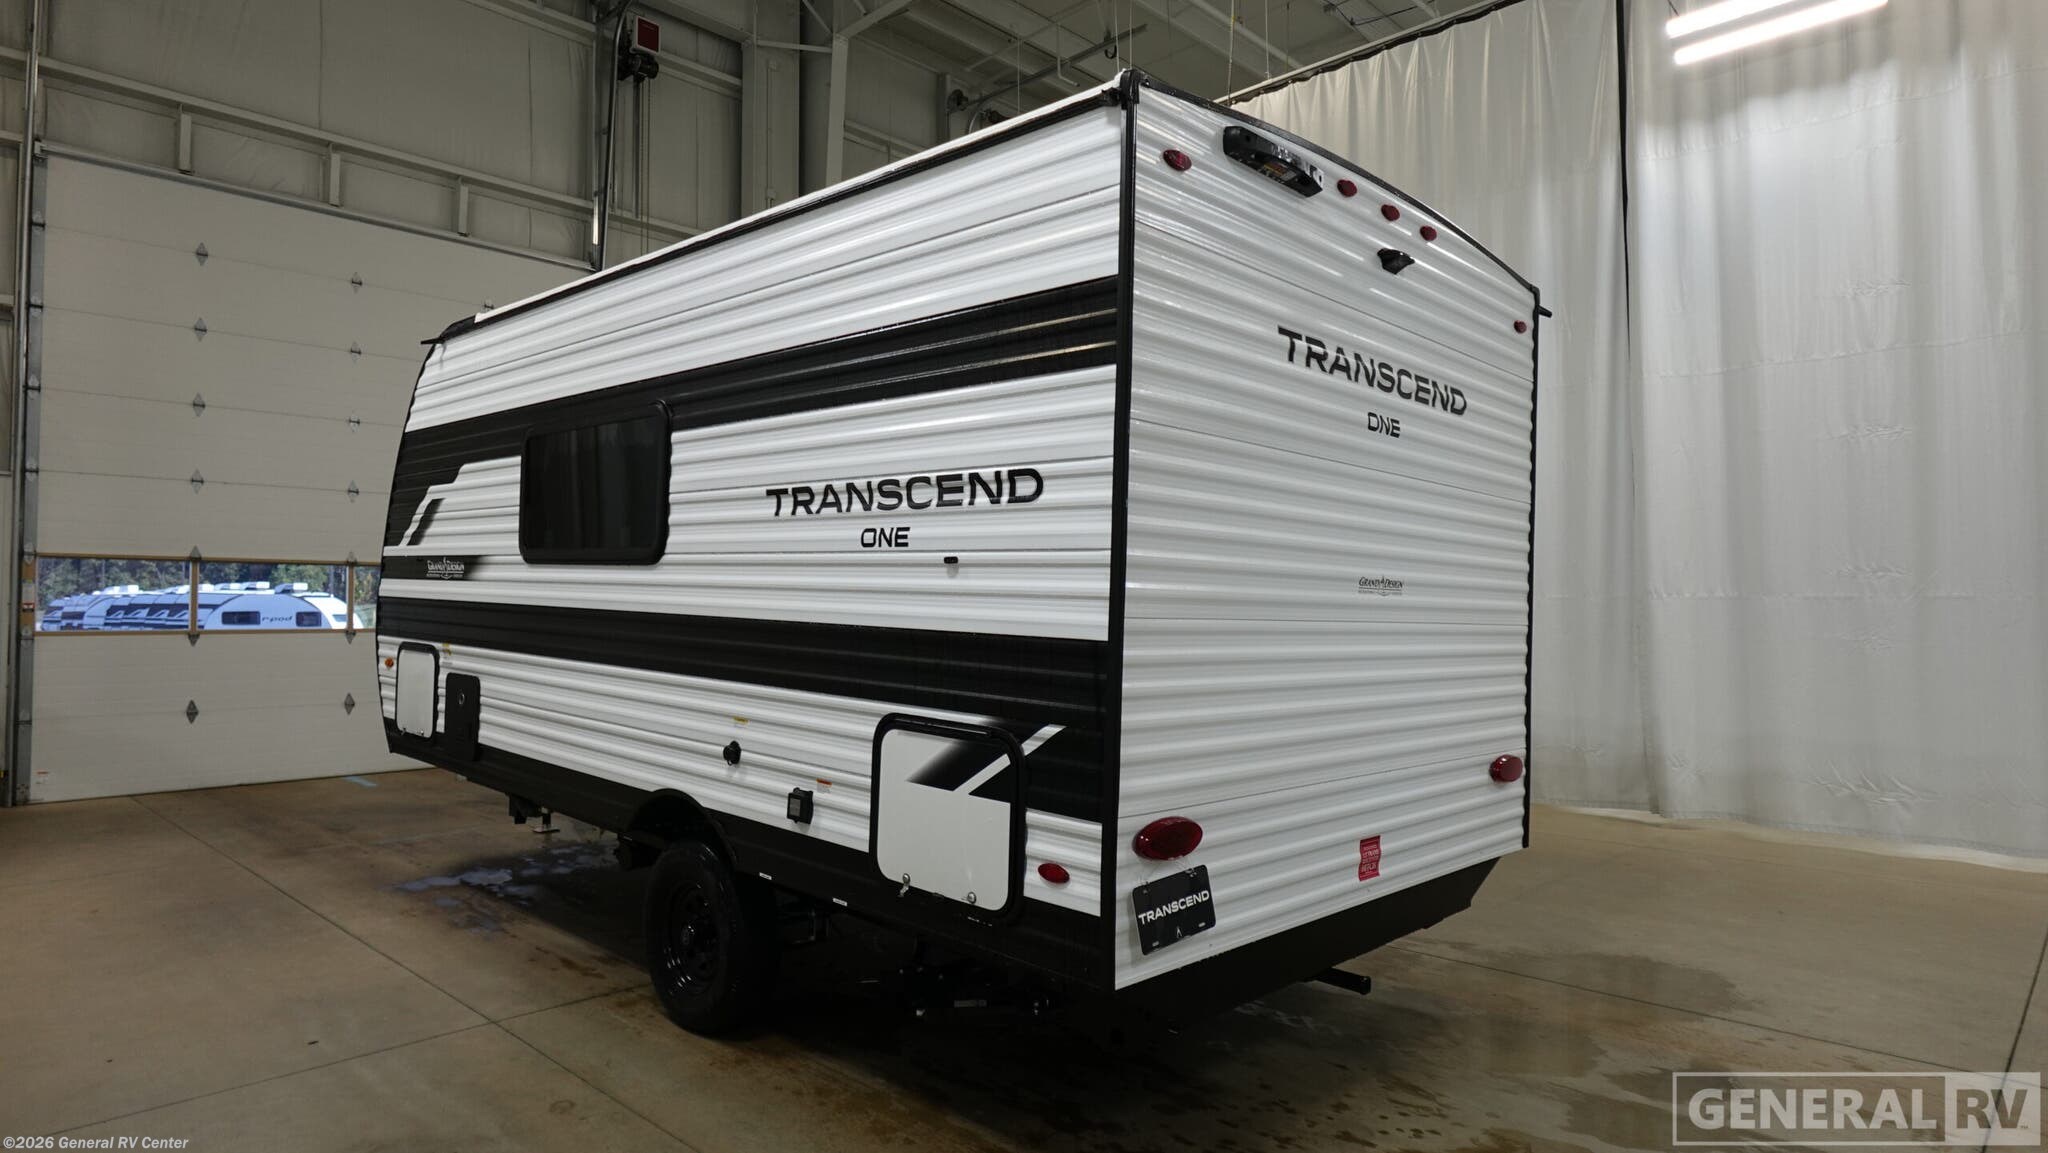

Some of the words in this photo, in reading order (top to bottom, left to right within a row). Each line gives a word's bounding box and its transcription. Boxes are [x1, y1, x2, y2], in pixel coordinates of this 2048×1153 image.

[1277, 325, 1467, 416] TRANSCEND
[1367, 411, 1401, 438] ONE
[766, 468, 1044, 517] TRANSCEND
[860, 526, 911, 548] ONE
[1138, 890, 1210, 925] TRANSCEND
